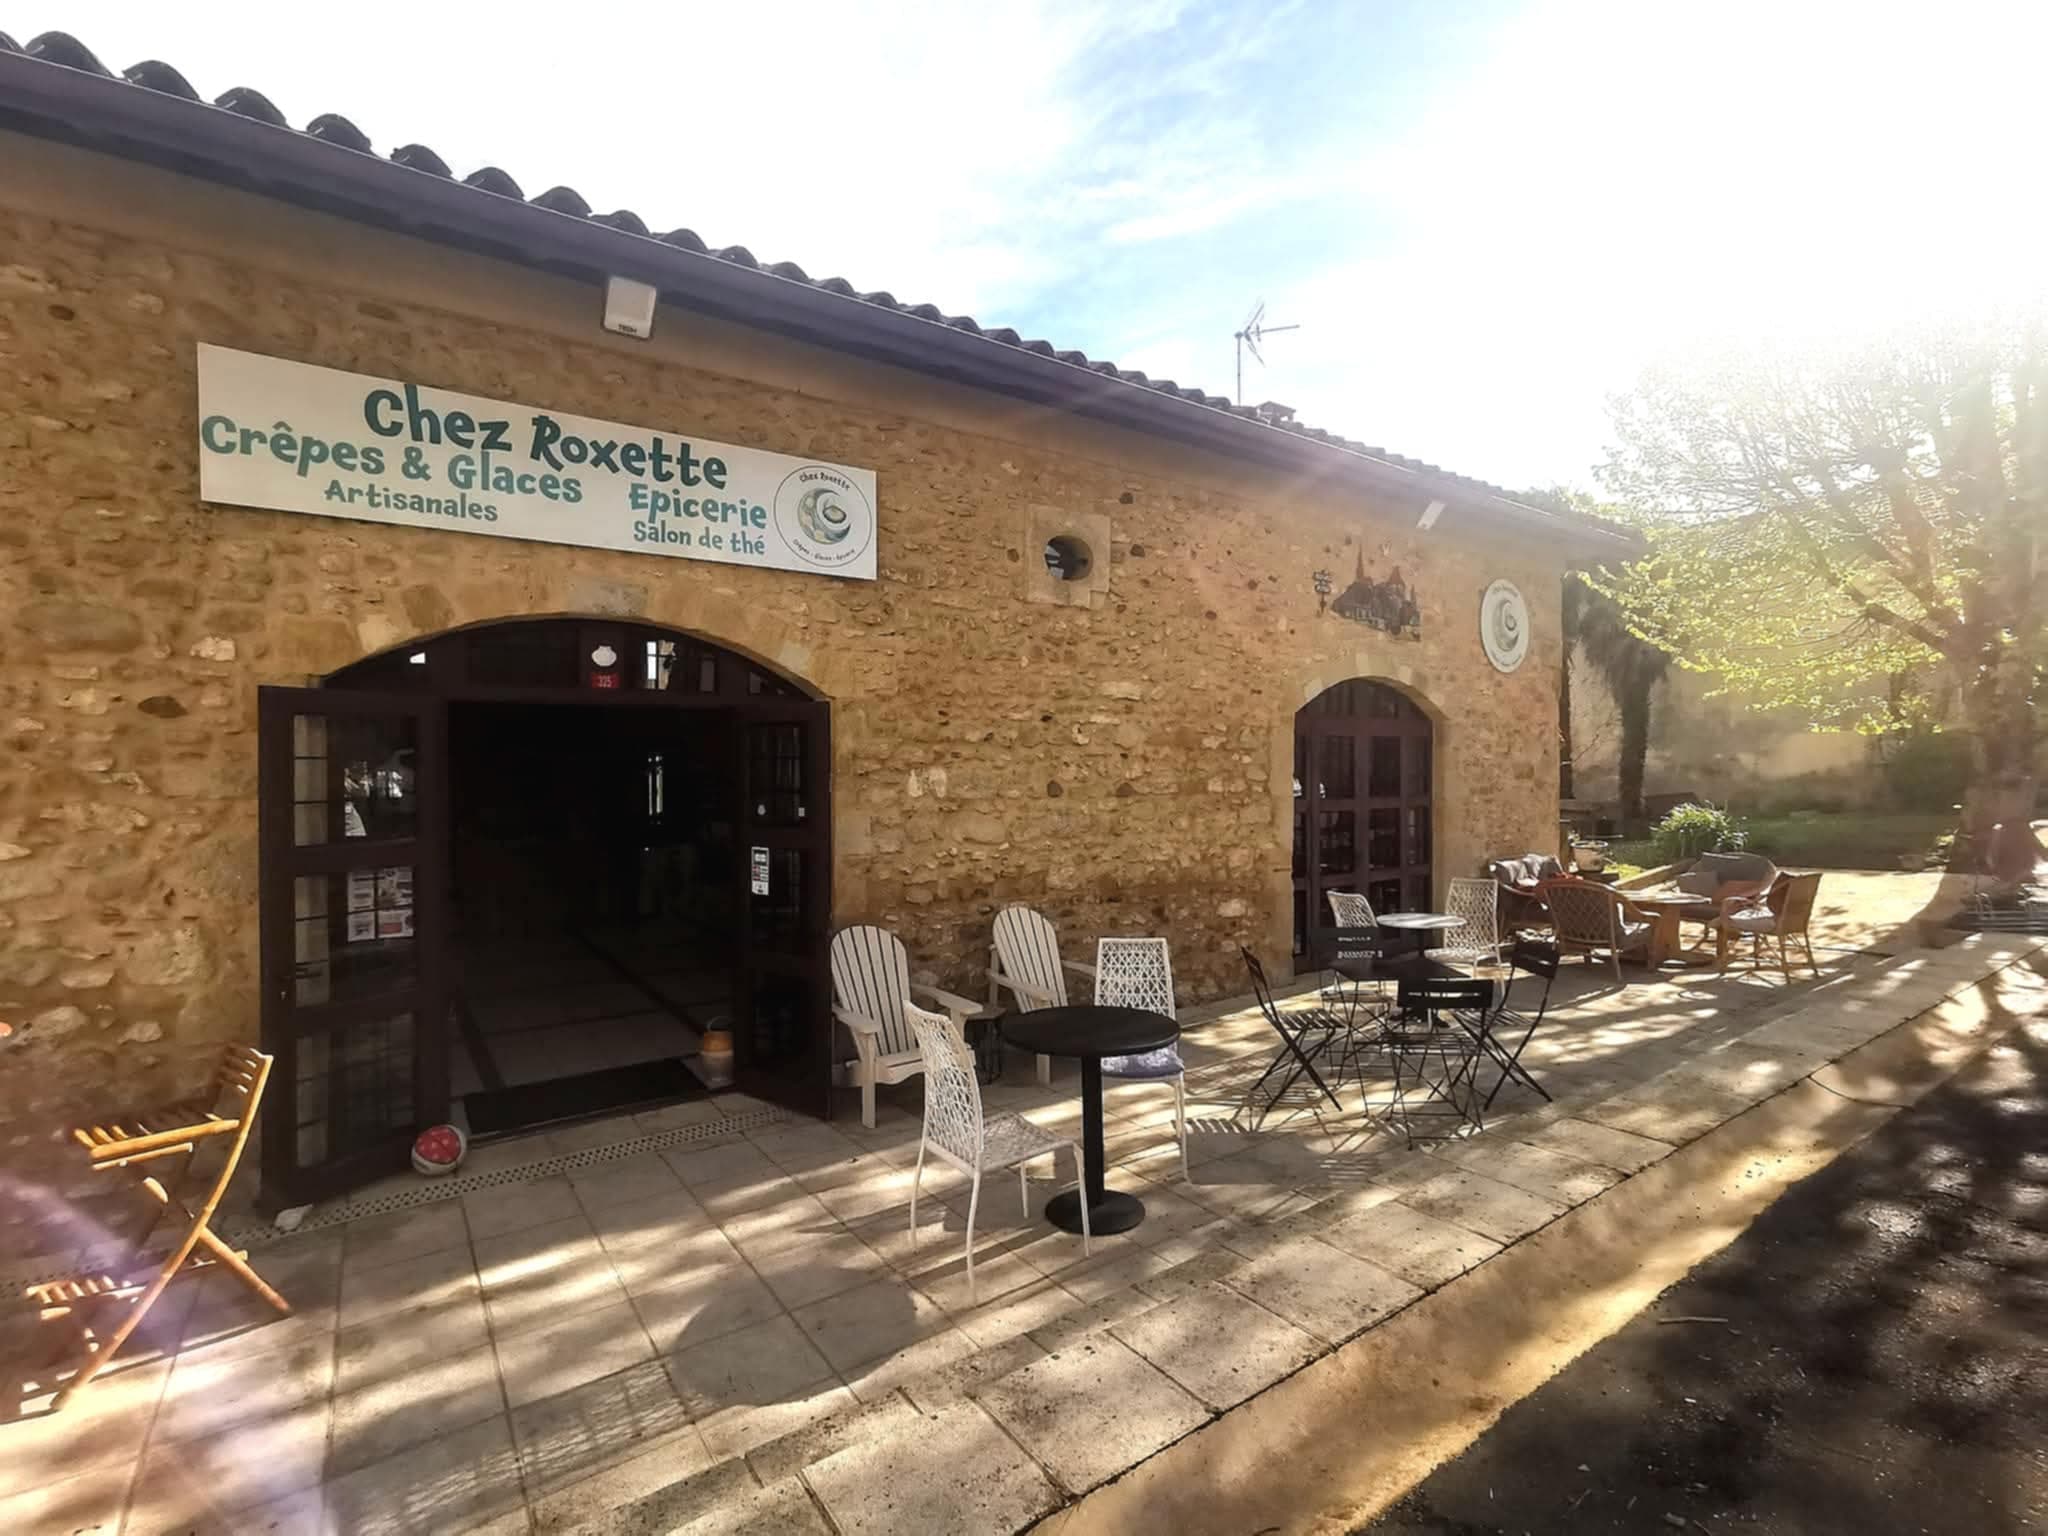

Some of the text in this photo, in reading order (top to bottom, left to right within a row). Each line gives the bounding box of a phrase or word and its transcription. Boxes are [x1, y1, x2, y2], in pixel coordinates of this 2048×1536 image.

[201, 416, 583, 503] Crêpes & Glaces
[364, 383, 727, 490] Chez Roxette
[324, 480, 498, 521] Artisanales
[629, 482, 767, 529] Epicerie
[634, 521, 765, 555] Salon de thé
